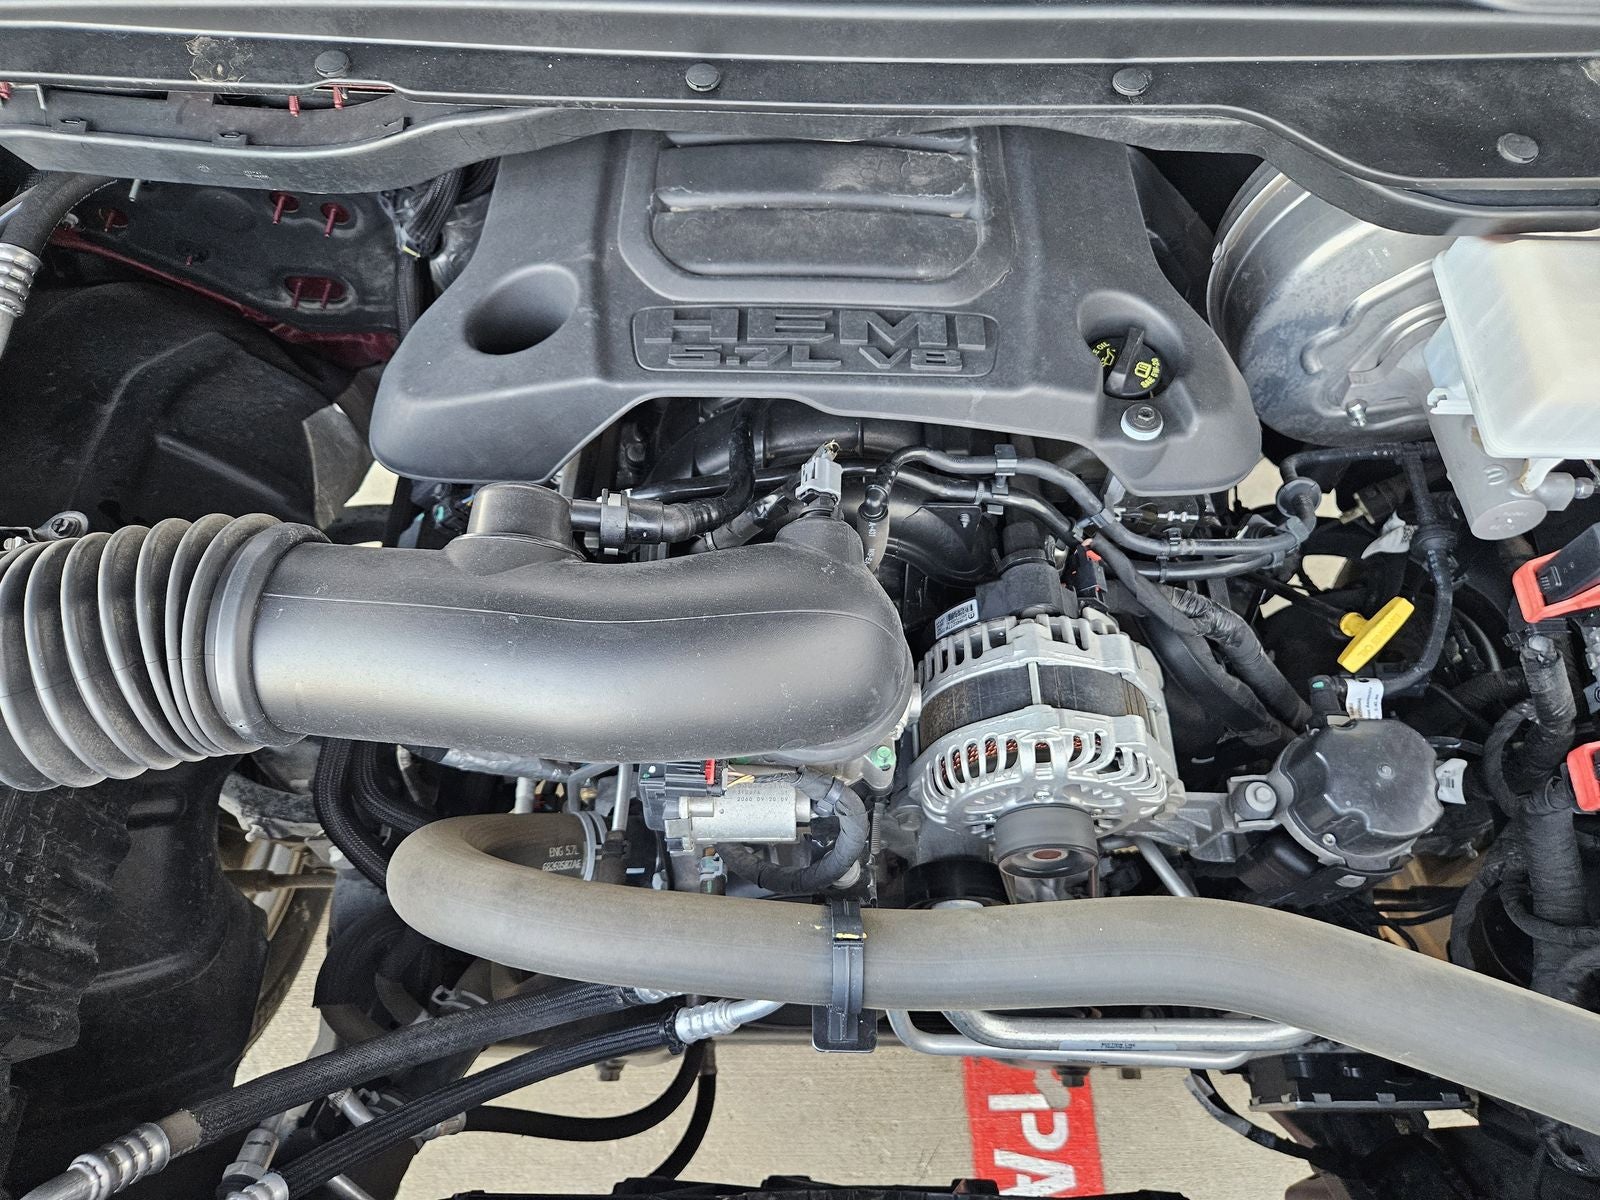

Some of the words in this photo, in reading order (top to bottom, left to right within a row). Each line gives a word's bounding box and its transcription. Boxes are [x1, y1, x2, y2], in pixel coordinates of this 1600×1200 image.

[644, 308, 986, 350] HEMI
[1096, 341, 1110, 351] OIL
[667, 344, 841, 367] 5.7L
[859, 347, 962, 371] V8
[1140, 376, 1156, 388] SAE
[549, 846, 564, 858] ENG
